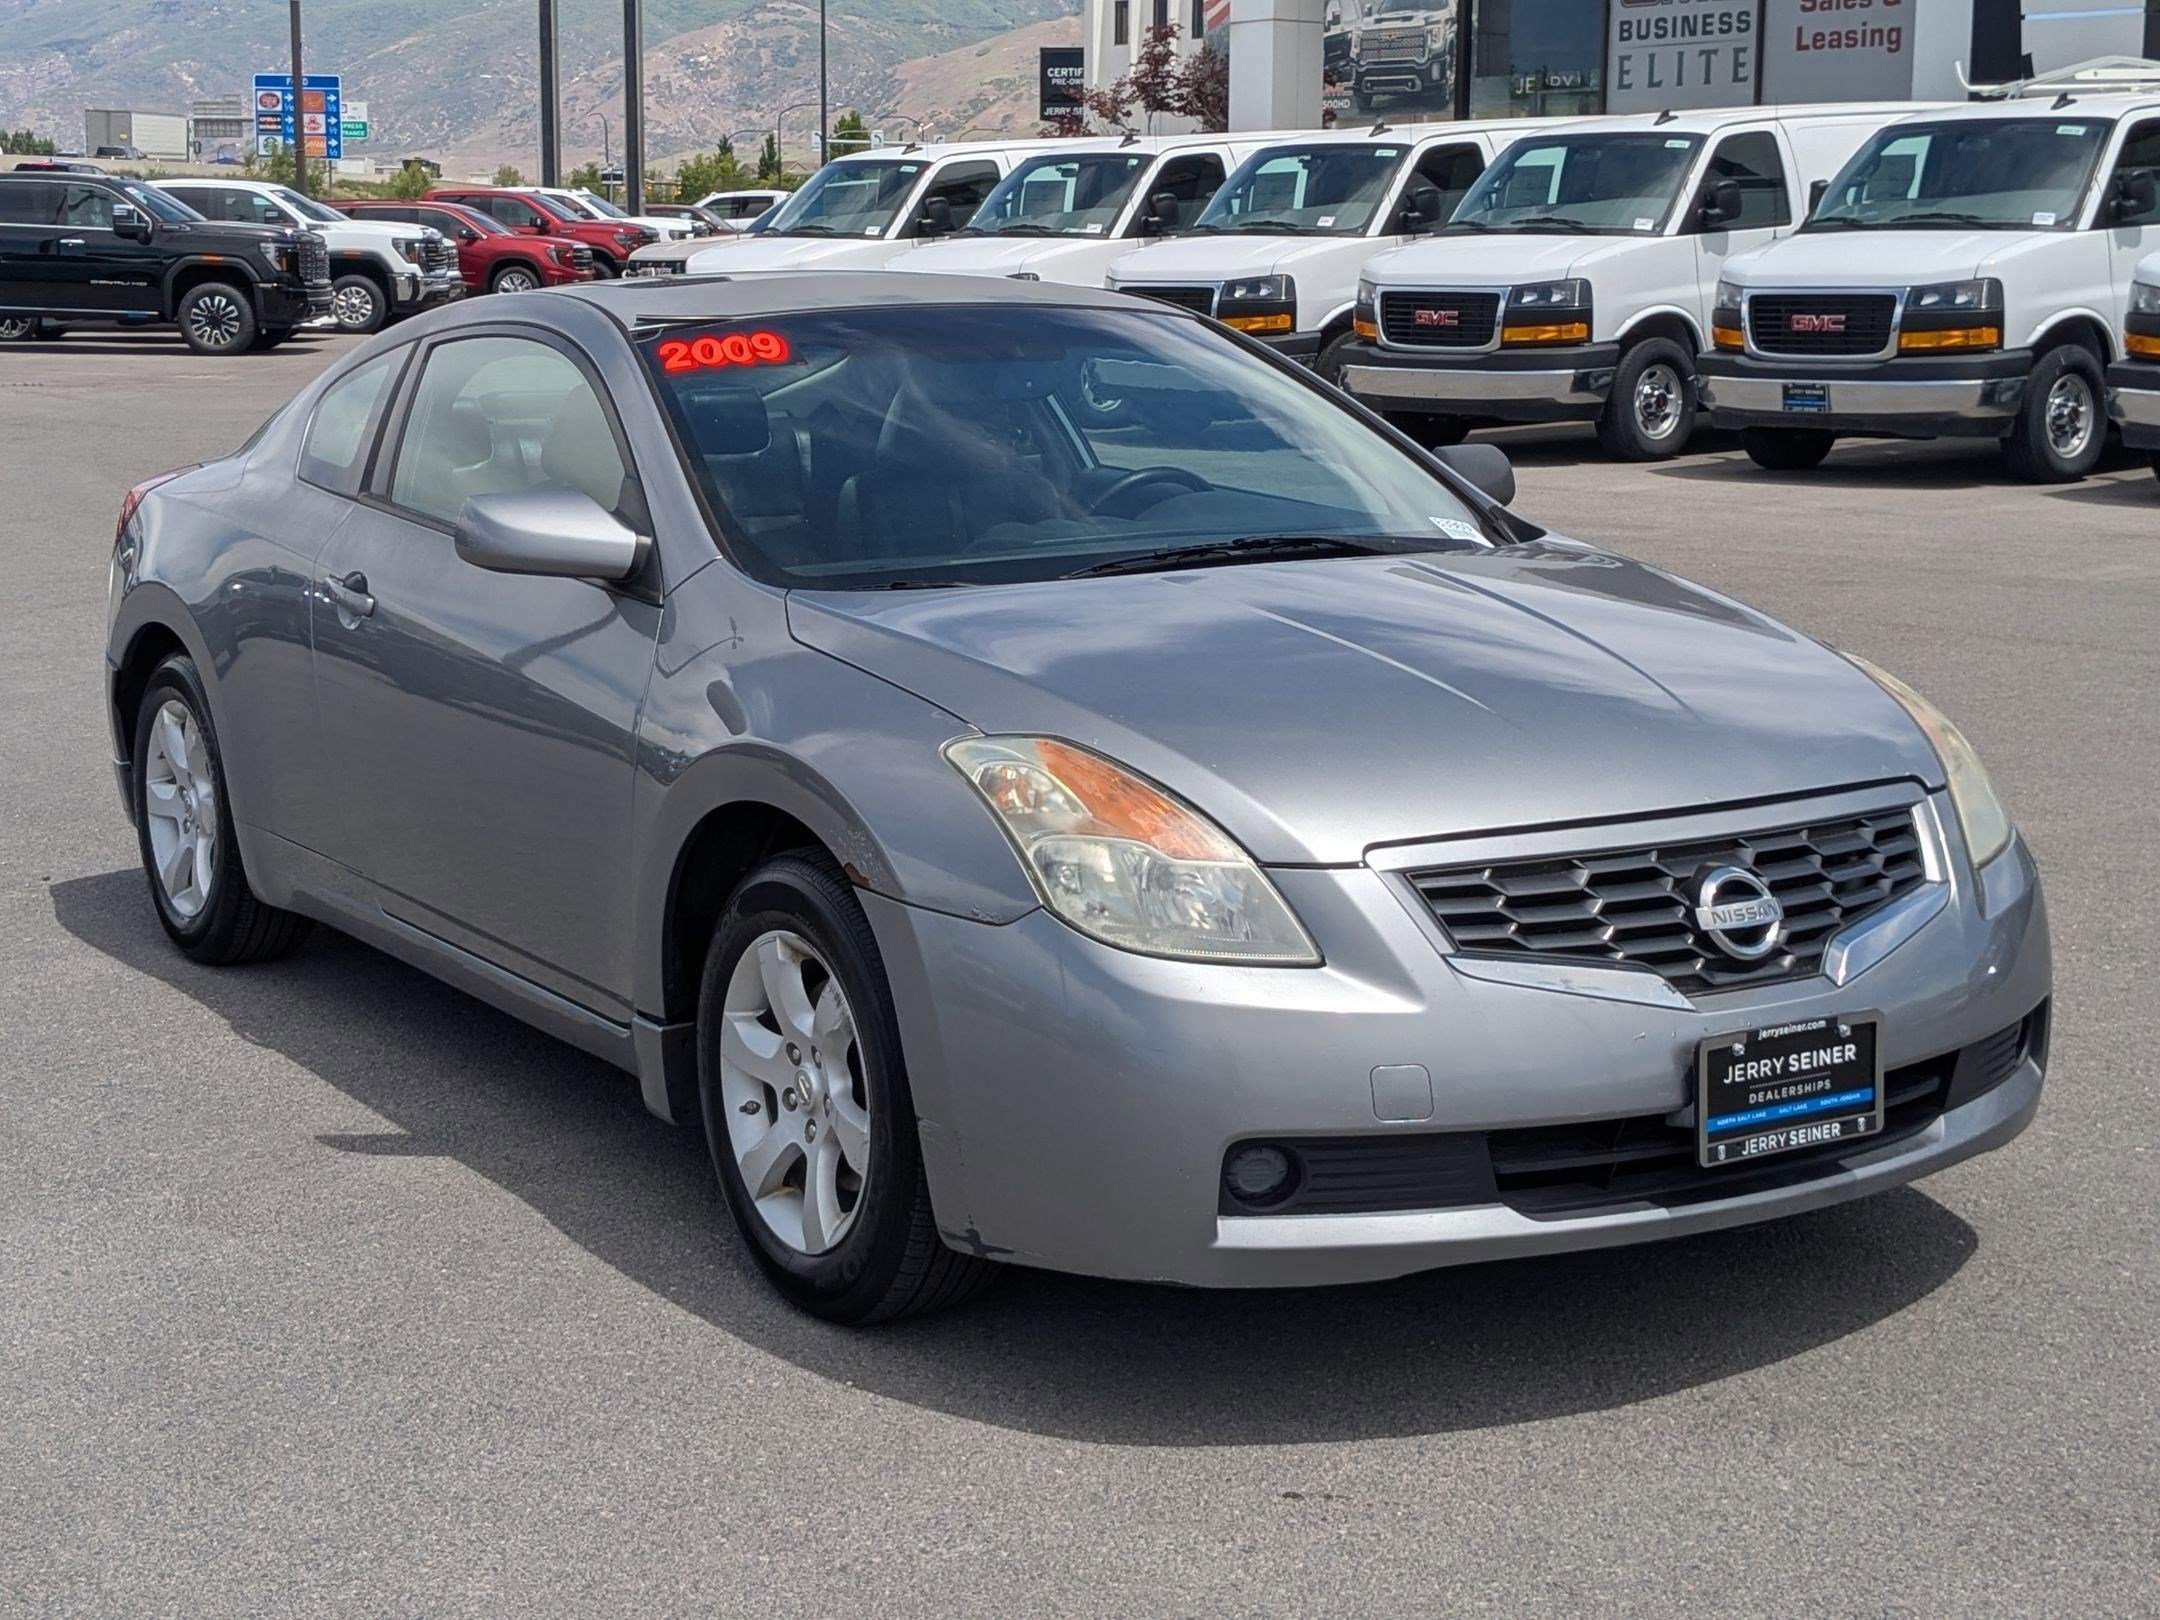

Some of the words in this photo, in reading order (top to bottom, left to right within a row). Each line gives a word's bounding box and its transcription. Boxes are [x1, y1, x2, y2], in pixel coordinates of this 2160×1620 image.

[1618, 10, 1751, 42] BUSINESS
[1796, 21, 1902, 53] Leasing
[1616, 47, 1749, 90] ELITE
[286, 78, 309, 86] FD
[1044, 106, 1072, 116] JERRY
[1415, 310, 1459, 326] GMC
[1791, 314, 1846, 332] GMC
[658, 333, 787, 371] 2009
[1711, 903, 1779, 925] NISSAN
[1758, 1019, 1827, 1040] jerryseiner.com
[1723, 1056, 1785, 1084] JERRY
[1788, 1044, 1857, 1072] SEINER
[1748, 1079, 1832, 1104] DEALERSHIPS
[1741, 1133, 1786, 1155] JERRY
[1789, 1122, 1841, 1145] SEINER
